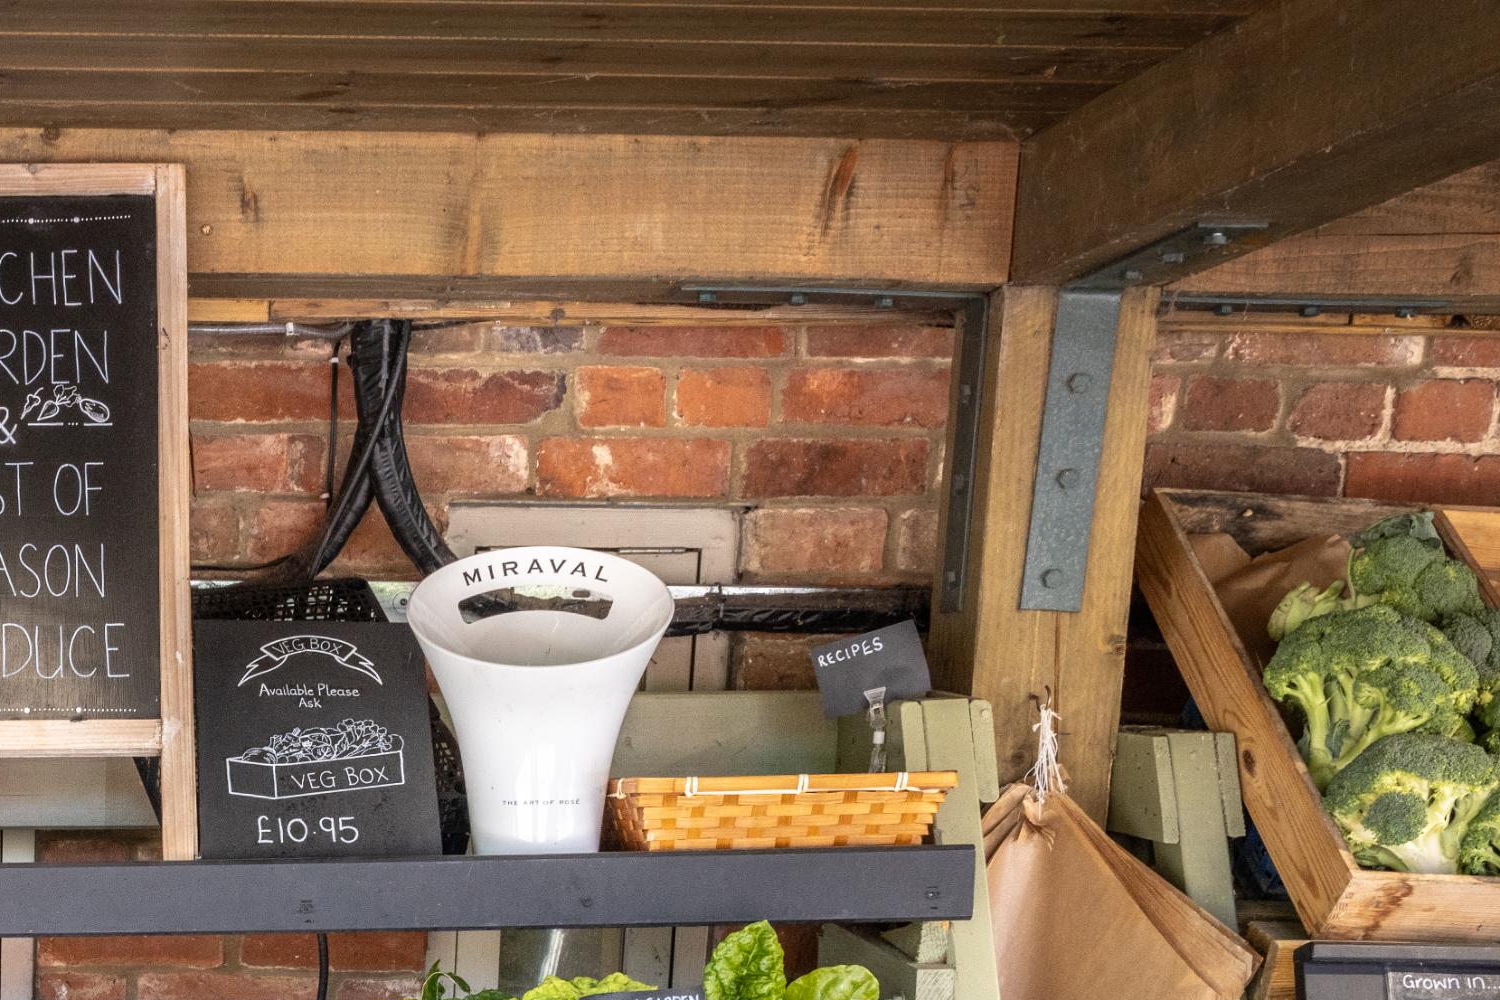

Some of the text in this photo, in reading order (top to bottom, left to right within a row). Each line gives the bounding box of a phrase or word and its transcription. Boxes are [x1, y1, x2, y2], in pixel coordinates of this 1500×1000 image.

[53, 462, 104, 517] OF
[462, 558, 608, 587] MIRAVAL
[272, 637, 343, 655] VEG BOX
[818, 637, 884, 667] RECIPES
[258, 683, 360, 697] Available Please
[298, 697, 322, 708] Ask
[291, 766, 389, 790] VEG BOX
[1403, 974, 1461, 990] Grown
